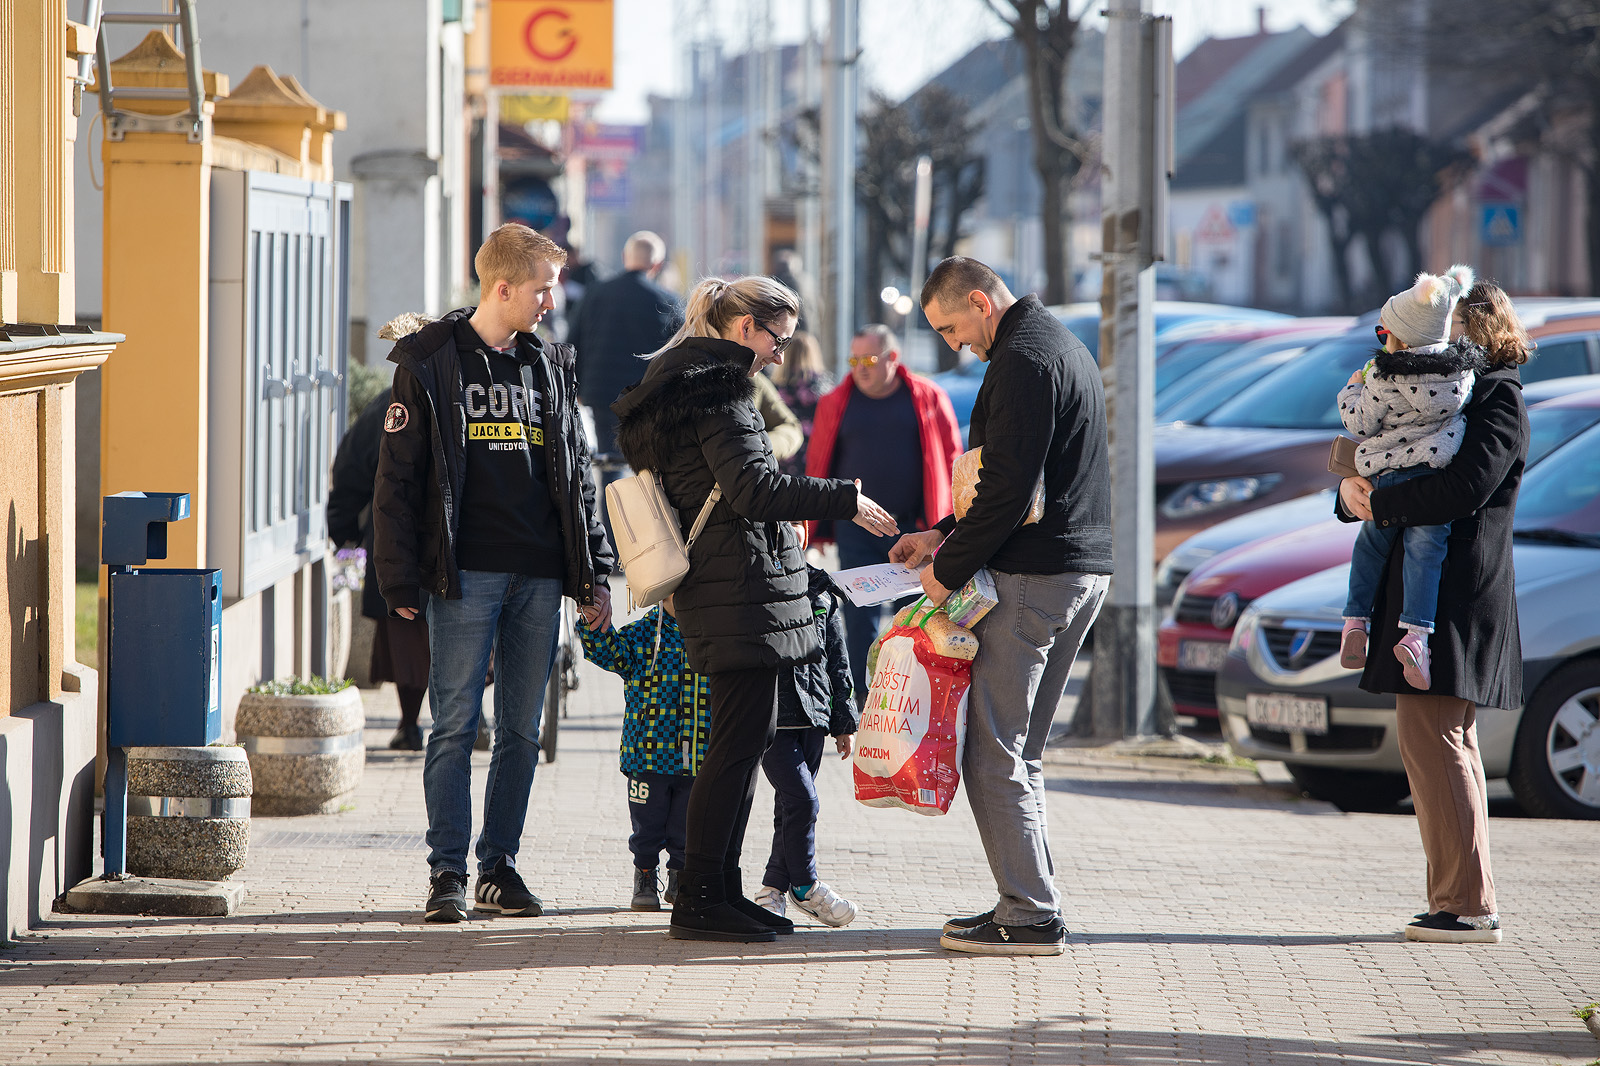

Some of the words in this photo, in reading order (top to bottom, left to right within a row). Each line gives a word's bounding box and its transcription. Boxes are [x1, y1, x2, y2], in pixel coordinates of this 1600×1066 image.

[465, 383, 542, 424] CORE
[472, 425, 501, 437] JACK
[504, 425, 512, 437] &
[516, 425, 542, 442] JES
[870, 671, 911, 692] DOST
[859, 712, 913, 736] TVARIMA
[858, 745, 891, 761] KONZUM
[630, 779, 649, 799] 56
